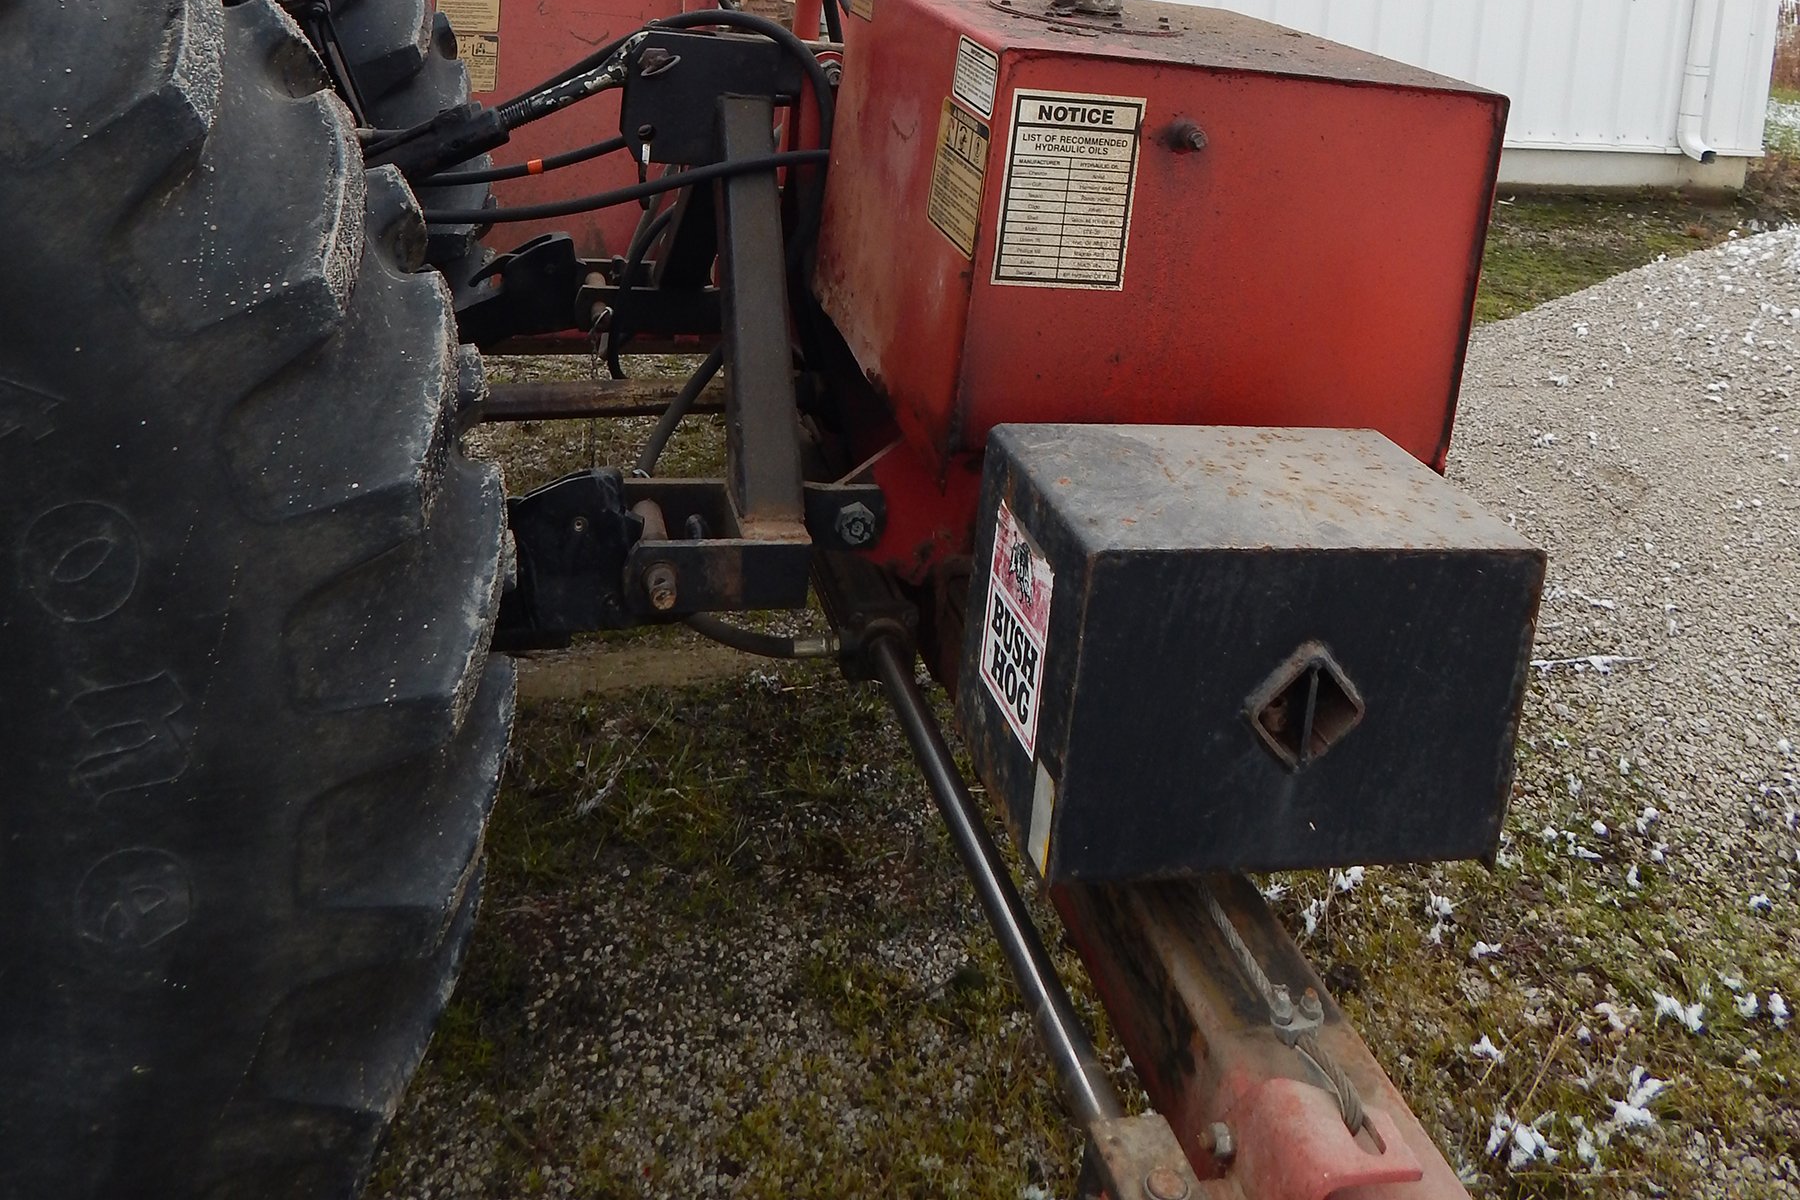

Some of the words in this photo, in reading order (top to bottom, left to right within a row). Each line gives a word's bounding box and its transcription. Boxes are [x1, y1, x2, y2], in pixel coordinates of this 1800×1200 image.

[1038, 105, 1115, 125] NOTICE
[1022, 133, 1042, 142] LIST
[1044, 134, 1057, 143] OF
[1059, 136, 1128, 148] RECOMMENDED
[1035, 143, 1087, 154] HYDRAULIC
[1088, 146, 1109, 155] OILS
[991, 592, 1038, 690] BUSH
[991, 639, 1030, 725] HOG
